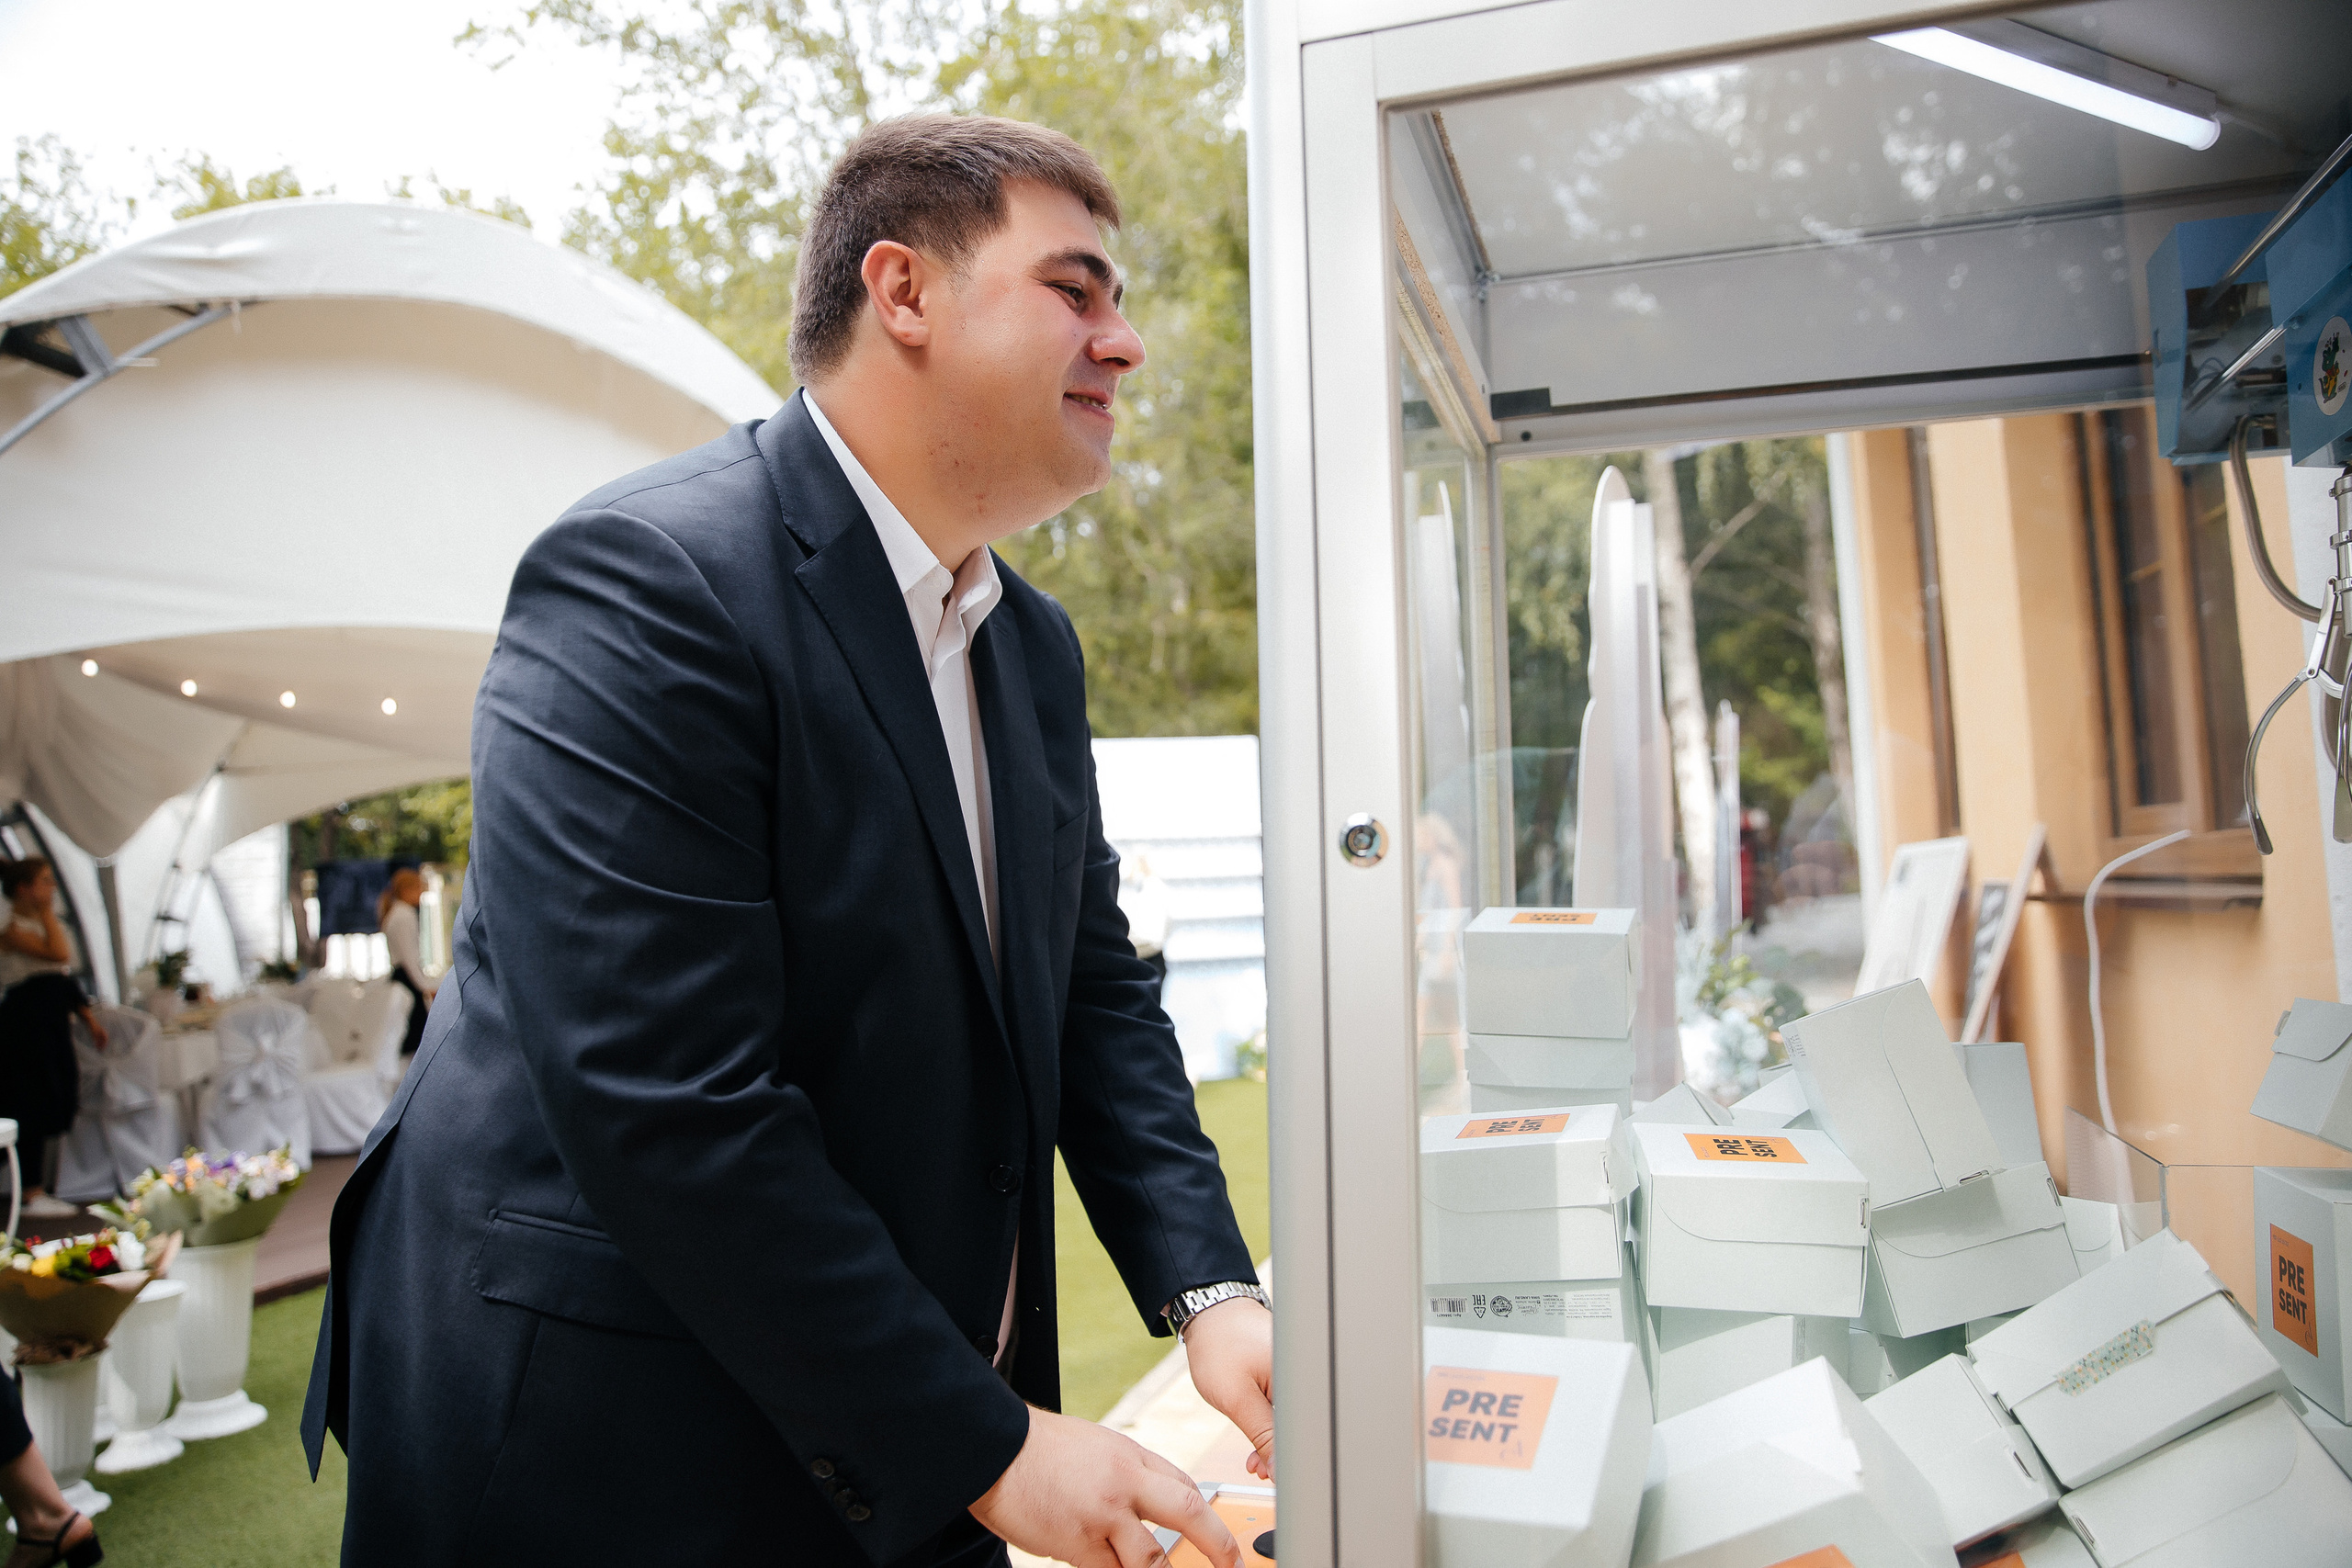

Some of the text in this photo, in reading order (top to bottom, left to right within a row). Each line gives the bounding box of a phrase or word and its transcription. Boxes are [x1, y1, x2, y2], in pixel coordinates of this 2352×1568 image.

[1485, 1120, 1519, 1134] PRE
[1517, 1118, 1545, 1132] SENT
[1713, 1138, 1749, 1156] PRE
[1744, 1138, 1778, 1158] SENT
[2278, 1254, 2306, 1296] PRE
[2278, 1287, 2308, 1325] SENT
[1442, 1388, 1523, 1417] PRE
[1428, 1416, 1518, 1443] SENT
